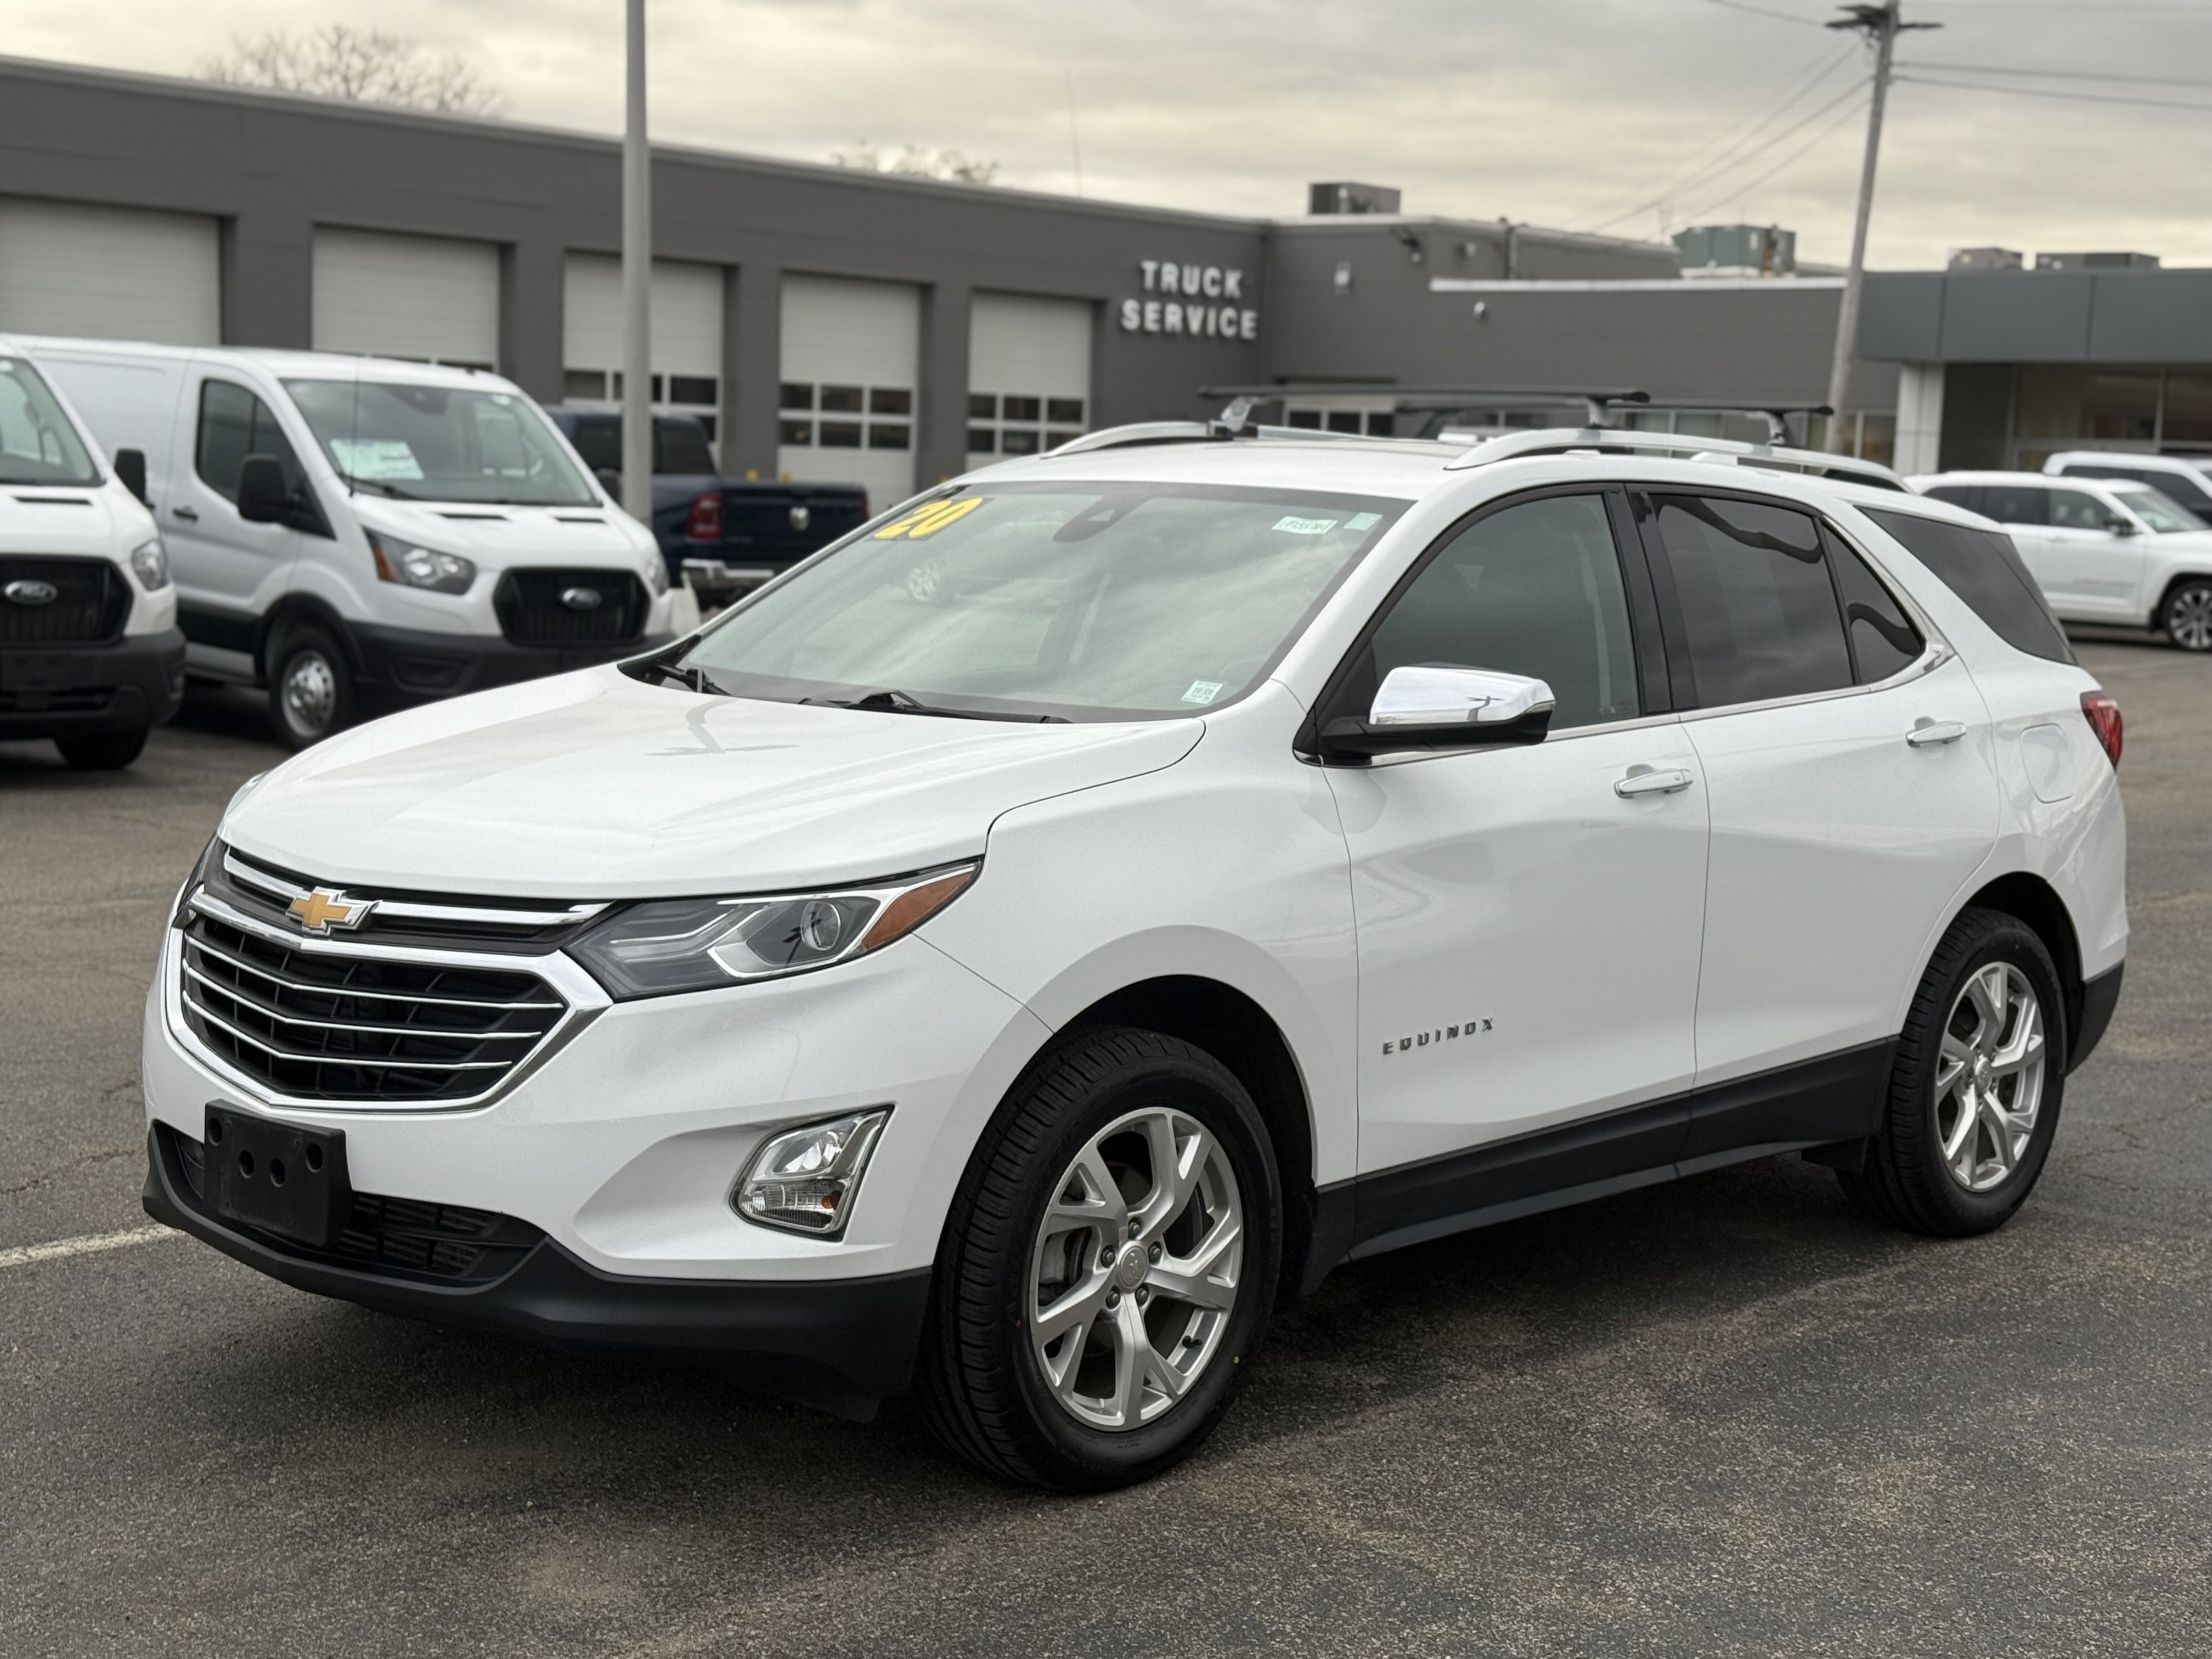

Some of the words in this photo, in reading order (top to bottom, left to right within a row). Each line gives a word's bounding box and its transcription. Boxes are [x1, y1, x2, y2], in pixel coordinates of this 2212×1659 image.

[1140, 260, 1243, 299] TRUCK
[1120, 298, 1258, 340] SERVICE
[873, 497, 984, 539] 20
[1383, 1017, 1493, 1055] EQUINOX
